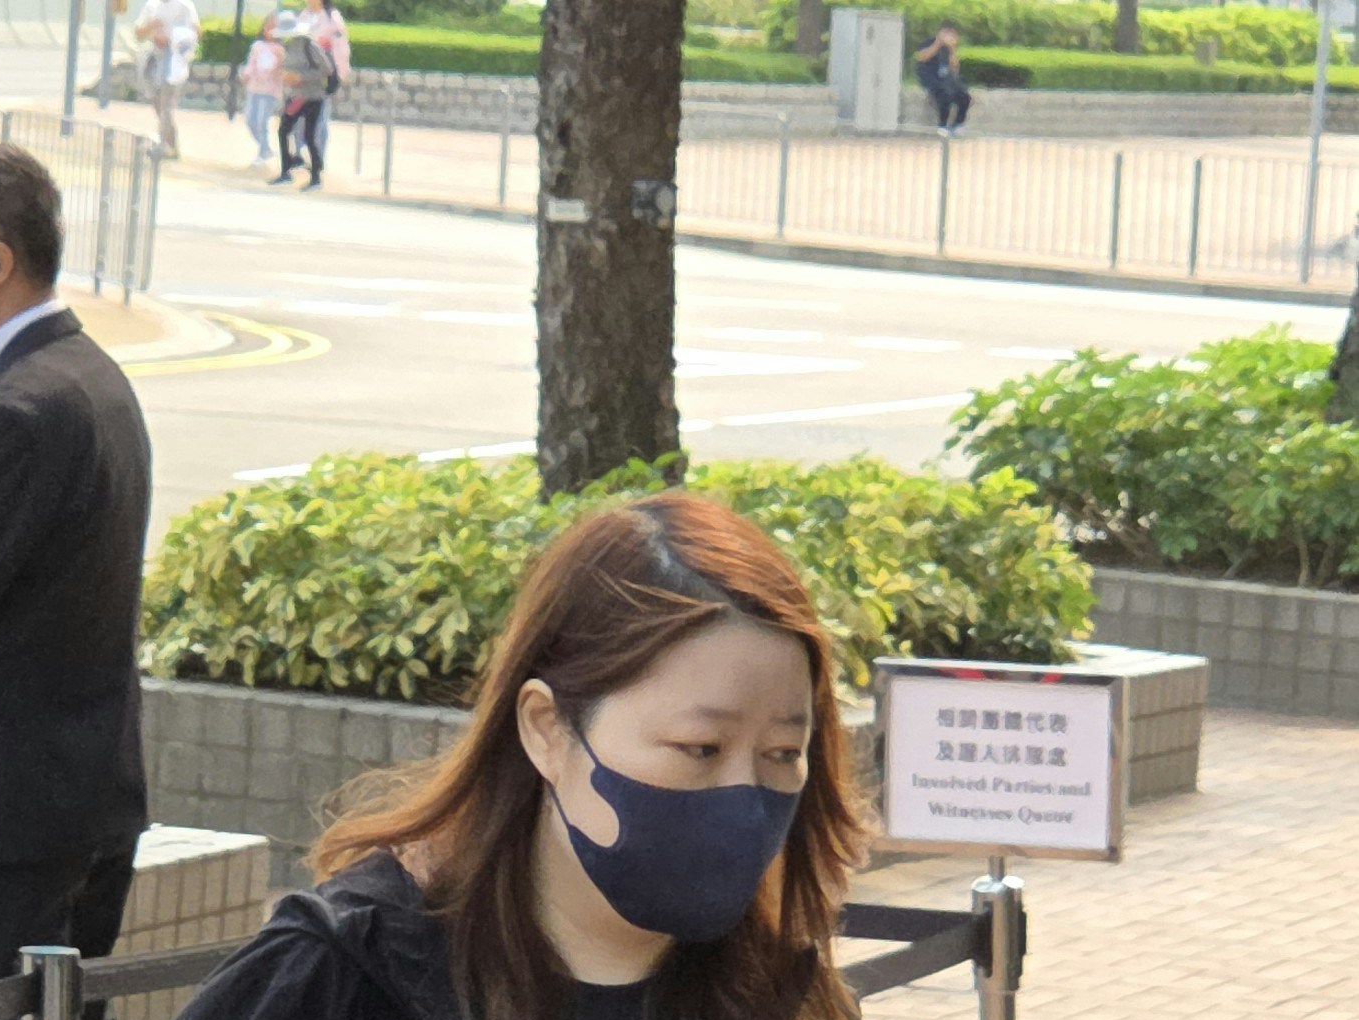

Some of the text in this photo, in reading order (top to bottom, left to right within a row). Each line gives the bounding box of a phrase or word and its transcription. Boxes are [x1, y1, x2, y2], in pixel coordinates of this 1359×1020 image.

[911, 773, 1092, 796] Involved Parties and
[928, 801, 1074, 825] Witnesses Queue
